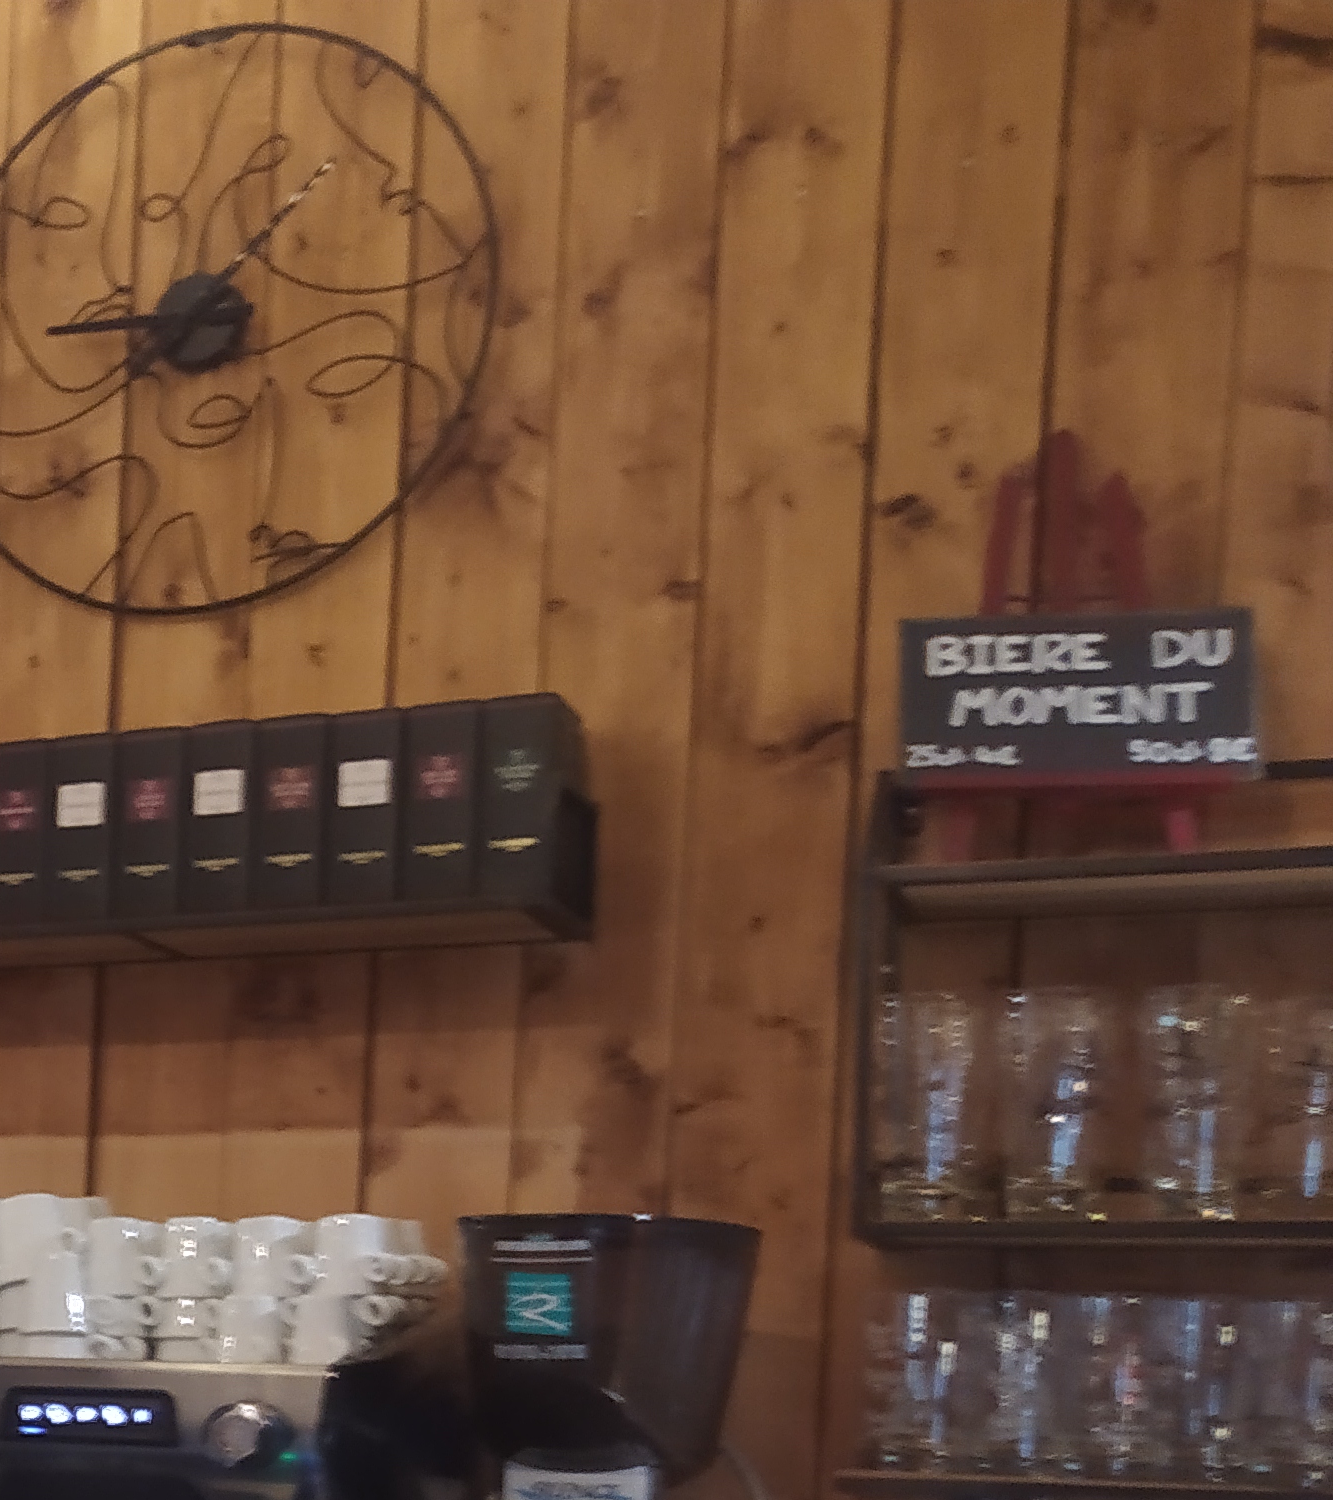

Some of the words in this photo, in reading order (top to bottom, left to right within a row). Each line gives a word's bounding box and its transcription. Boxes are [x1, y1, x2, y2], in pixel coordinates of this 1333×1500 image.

[925, 632, 1113, 678] BIERE
[1150, 628, 1233, 669] DU
[947, 681, 1215, 728] MOMENT
